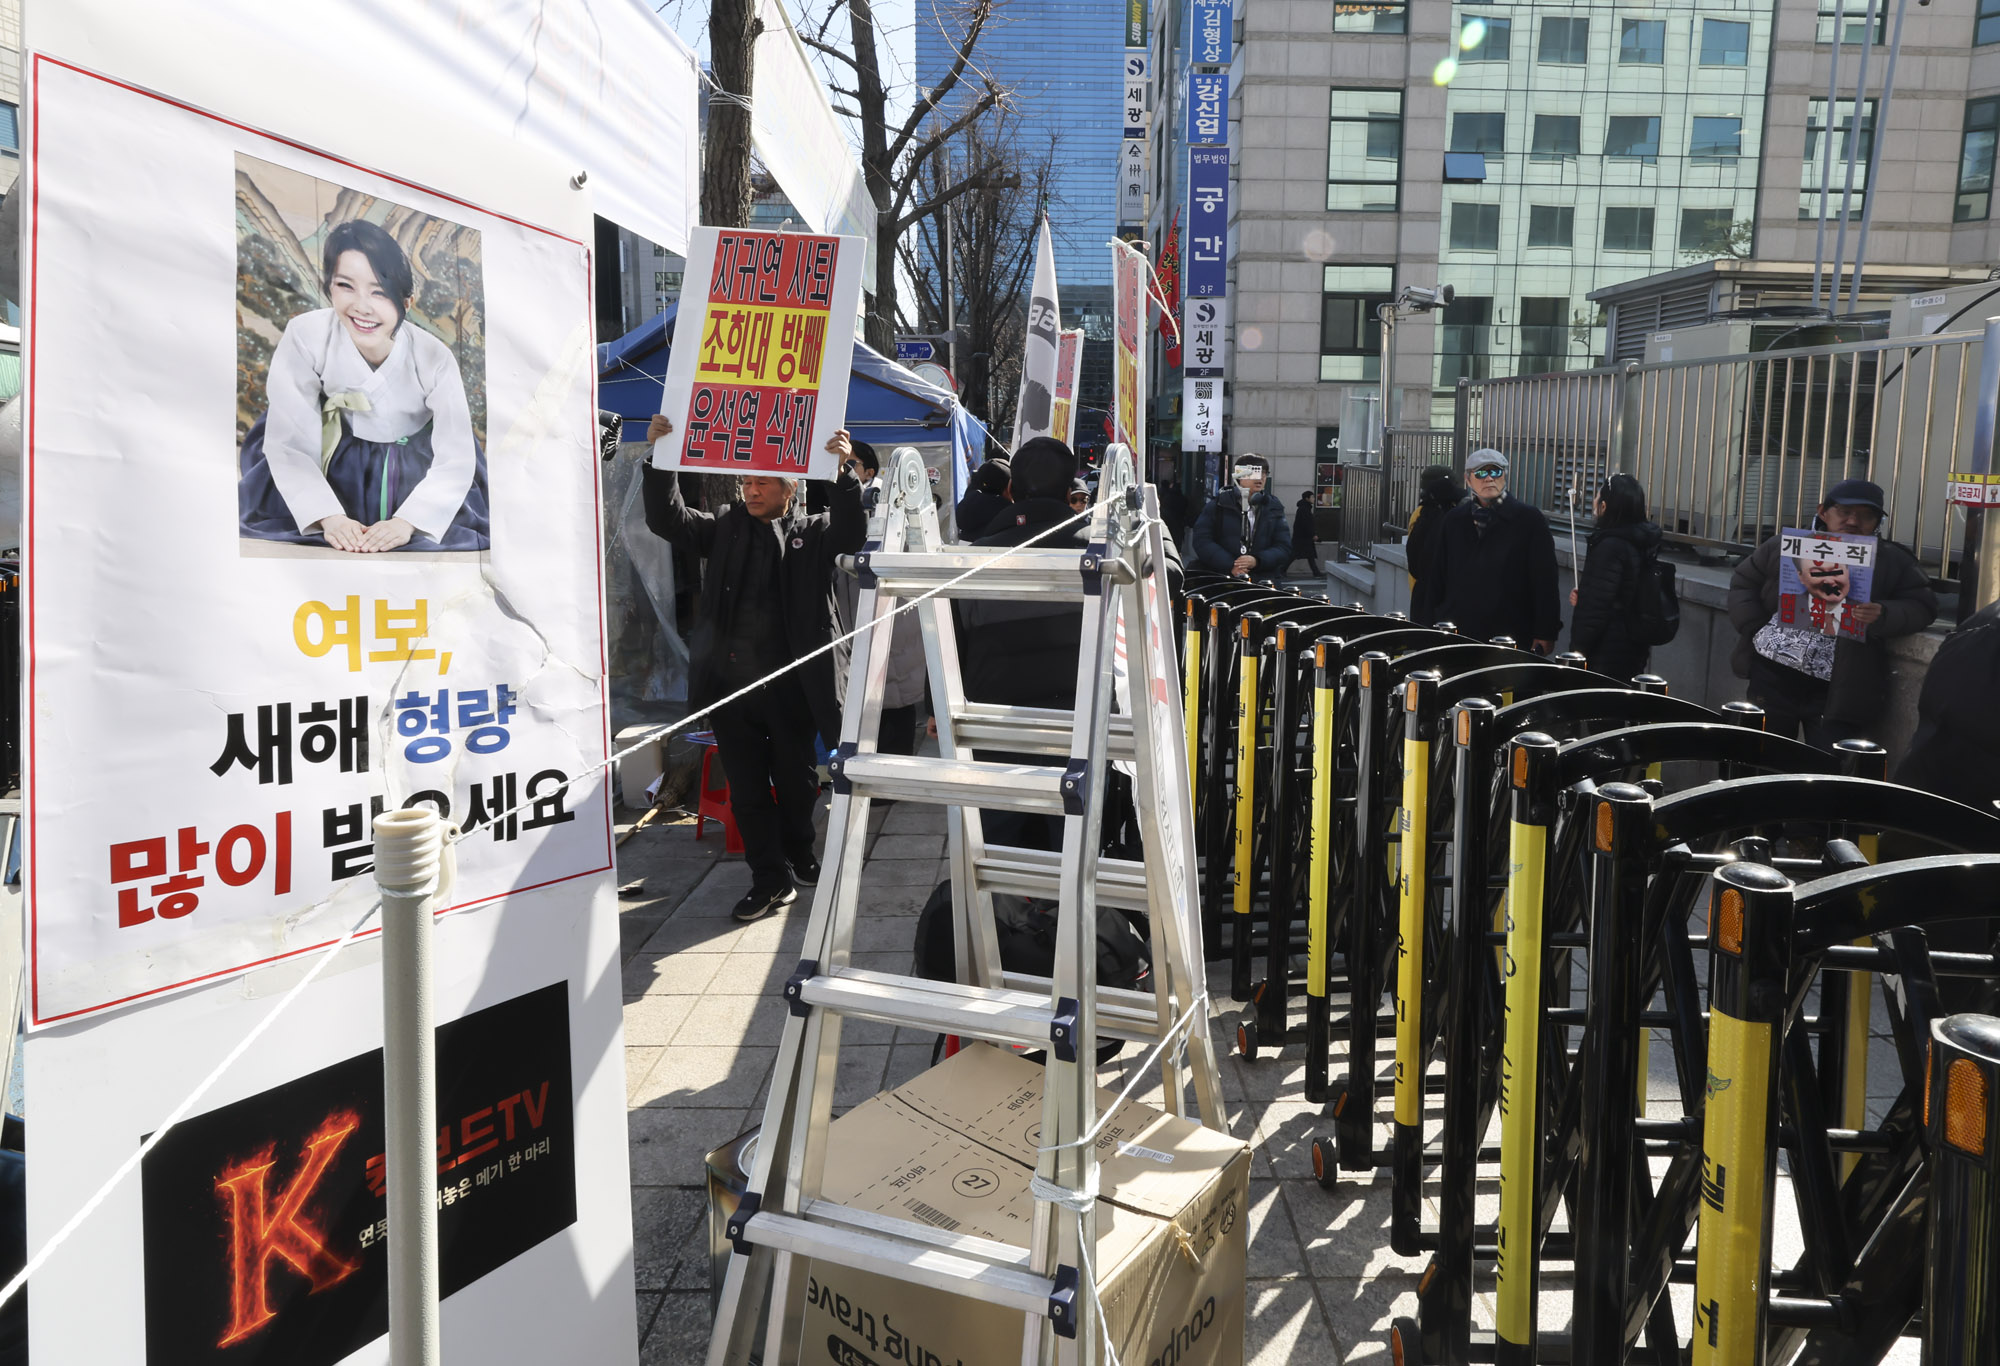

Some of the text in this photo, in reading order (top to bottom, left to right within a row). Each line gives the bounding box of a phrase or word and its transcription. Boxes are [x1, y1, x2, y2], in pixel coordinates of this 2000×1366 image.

[1131, 0, 1142, 44] SUBWAY
[1202, 9, 1222, 62] 김형상
[1127, 88, 1143, 123] 세광
[1195, 85, 1222, 135] 강신업
[1194, 154, 1228, 164] 법무법인
[713, 236, 836, 306] 지귀연 사퇴
[1200, 286, 1213, 294] 3F
[700, 309, 826, 384] 조희대 방빼
[1196, 330, 1214, 364] 세광
[685, 387, 815, 467] 윤석열 삭제
[1958, 486, 1980, 499] 접근금지
[292, 594, 453, 675] 여보,
[209, 683, 516, 786] 새해 형량
[110, 810, 292, 928] 많이
[1007, 1090, 1036, 1112] 테이프
[366, 1079, 549, 1198] 드TV
[476, 1160, 503, 1186] 메기
[508, 1151, 522, 1172] 한
[525, 1136, 550, 1162] 마리
[1096, 1127, 1126, 1150] 테이프
[890, 1164, 927, 1189] 테이프
[962, 1174, 992, 1190] 27
[214, 1114, 361, 1349] K
